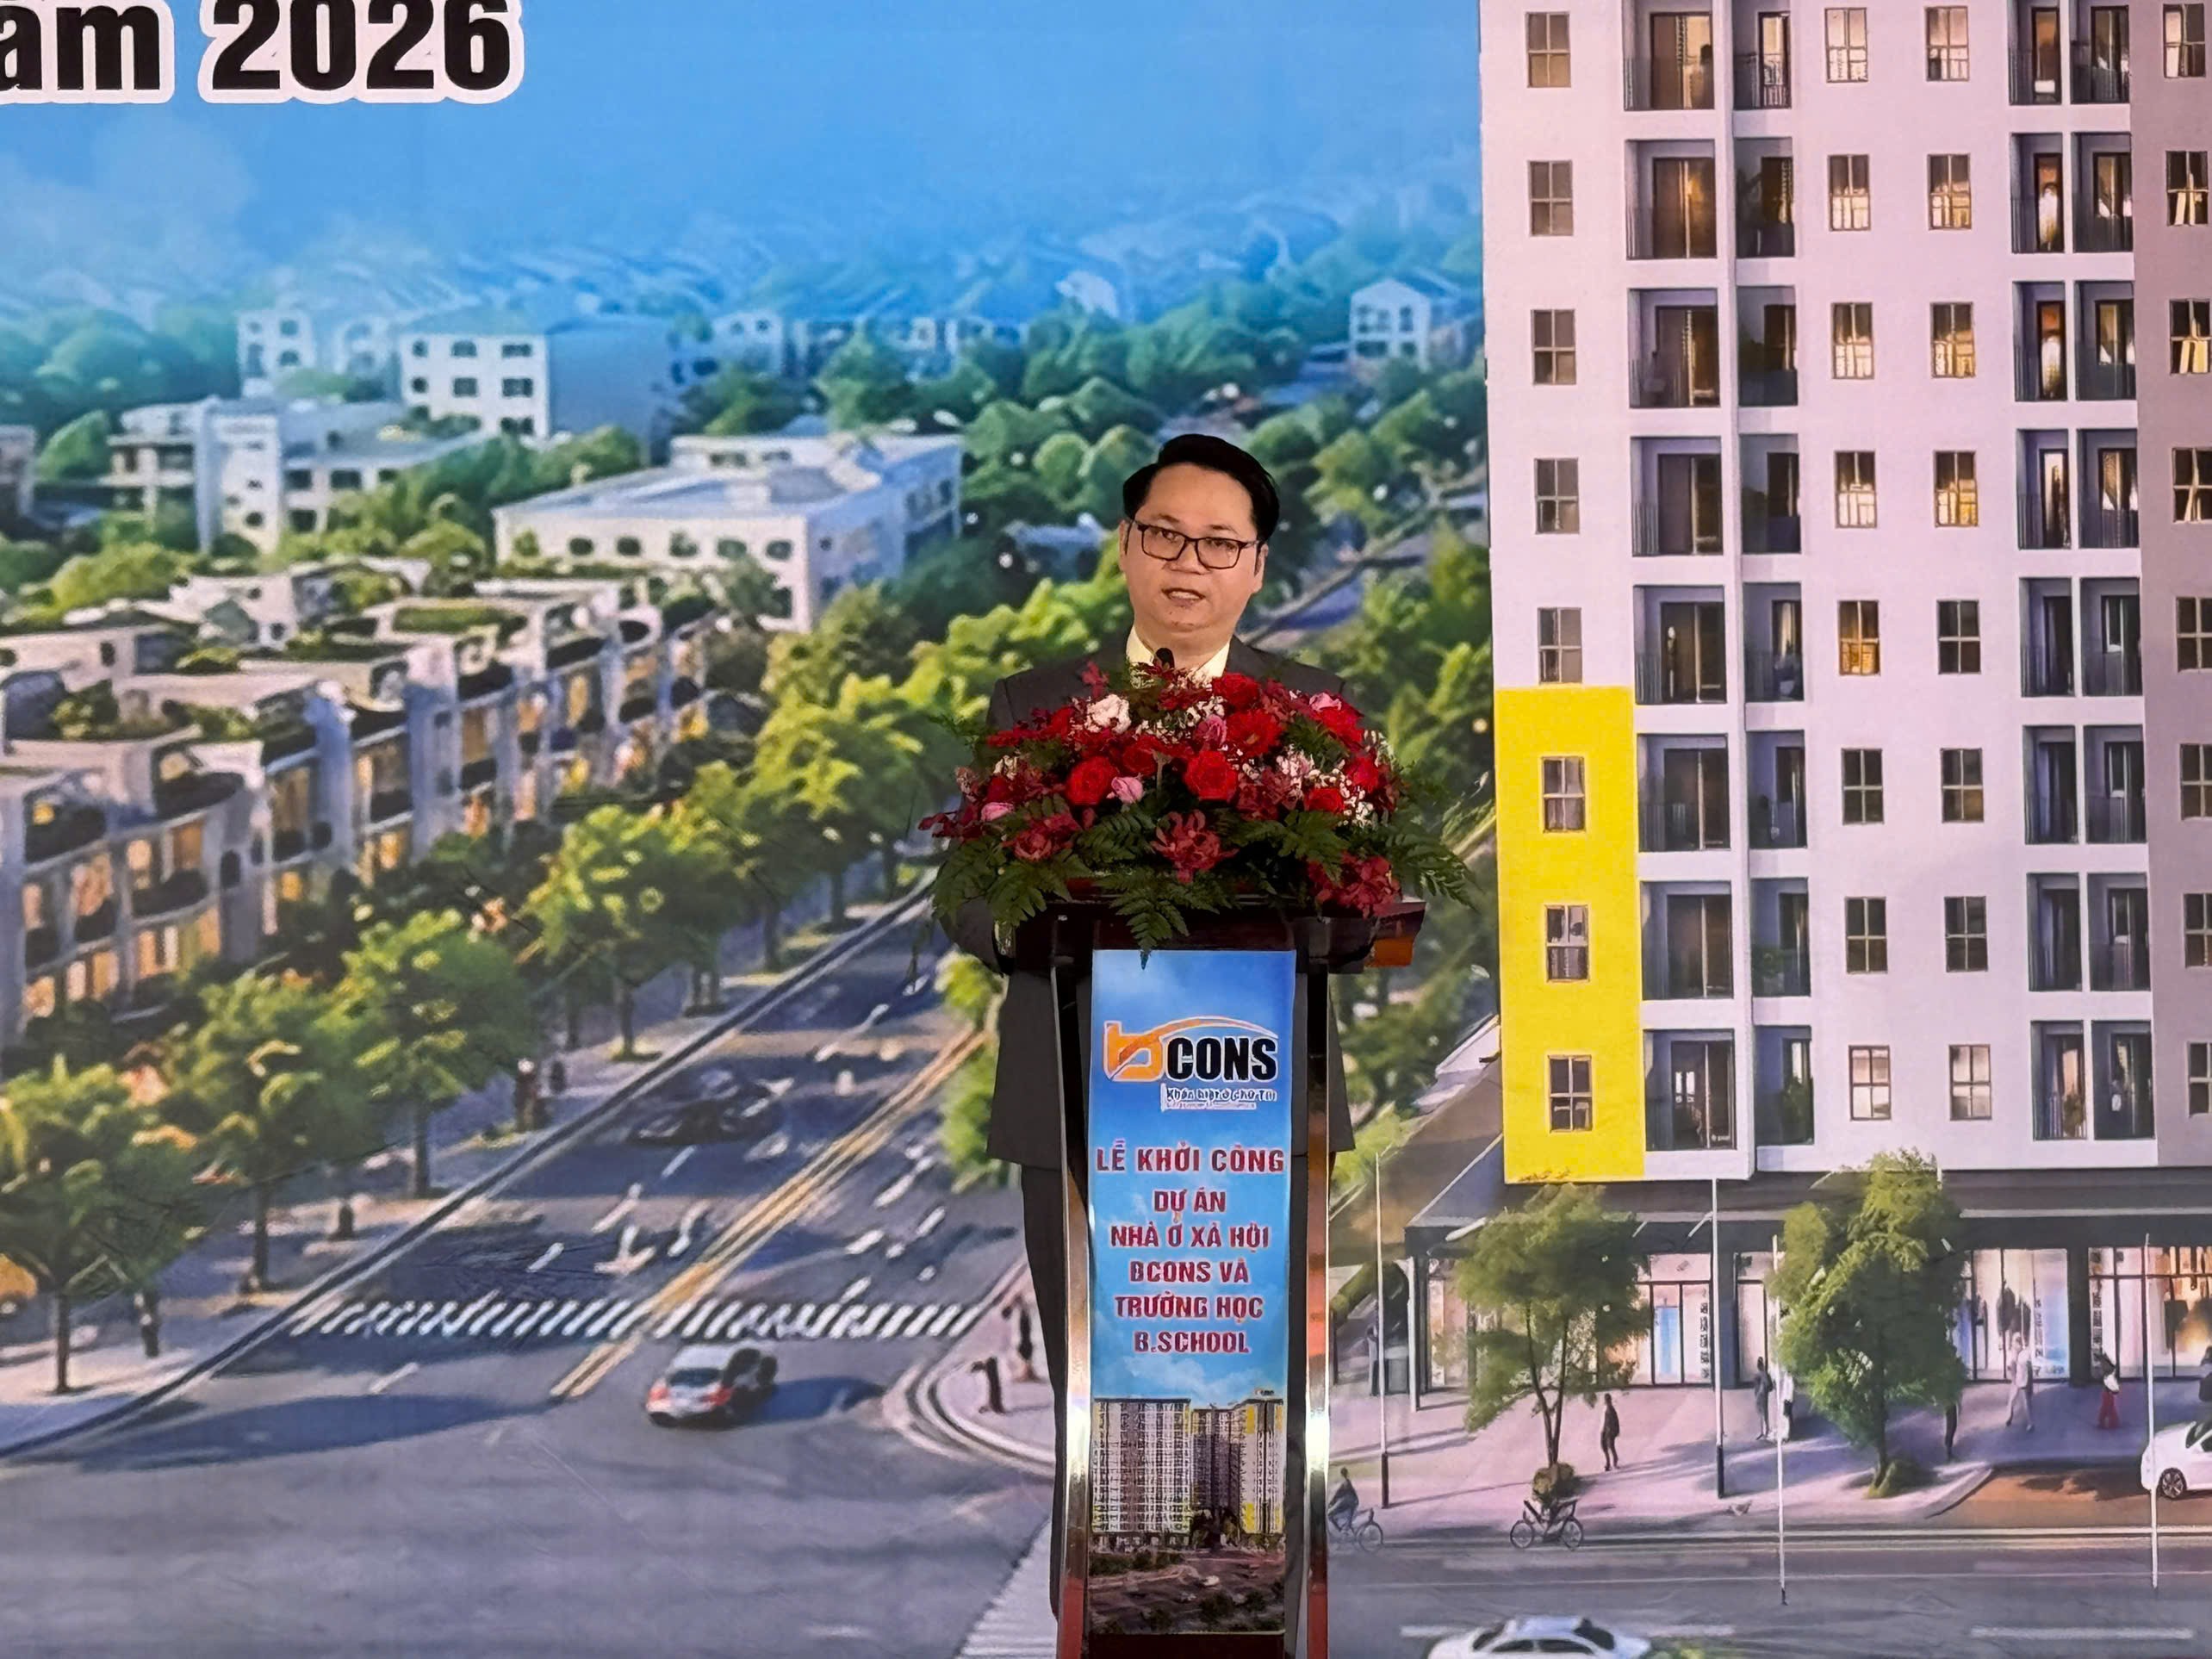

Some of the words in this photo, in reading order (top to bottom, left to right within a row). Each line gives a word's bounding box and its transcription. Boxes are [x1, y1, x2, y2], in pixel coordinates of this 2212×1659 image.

[212, 0, 510, 90] 2026
[1097, 1140, 1126, 1171] LỄ
[1137, 1141, 1200, 1171] KHỞI
[1211, 1144, 1284, 1172] CÔNG
[1193, 1186, 1227, 1213] ÁN
[1110, 1221, 1159, 1247] NHÀ
[1229, 1222, 1269, 1253] HỘI
[1130, 1260, 1211, 1283] BCONS
[1219, 1257, 1249, 1283] VÀ
[1115, 1291, 1208, 1319] TRƯỜNG
[1215, 1296, 1264, 1324] HỌC
[1134, 1331, 1249, 1353] B.SCHOOL
